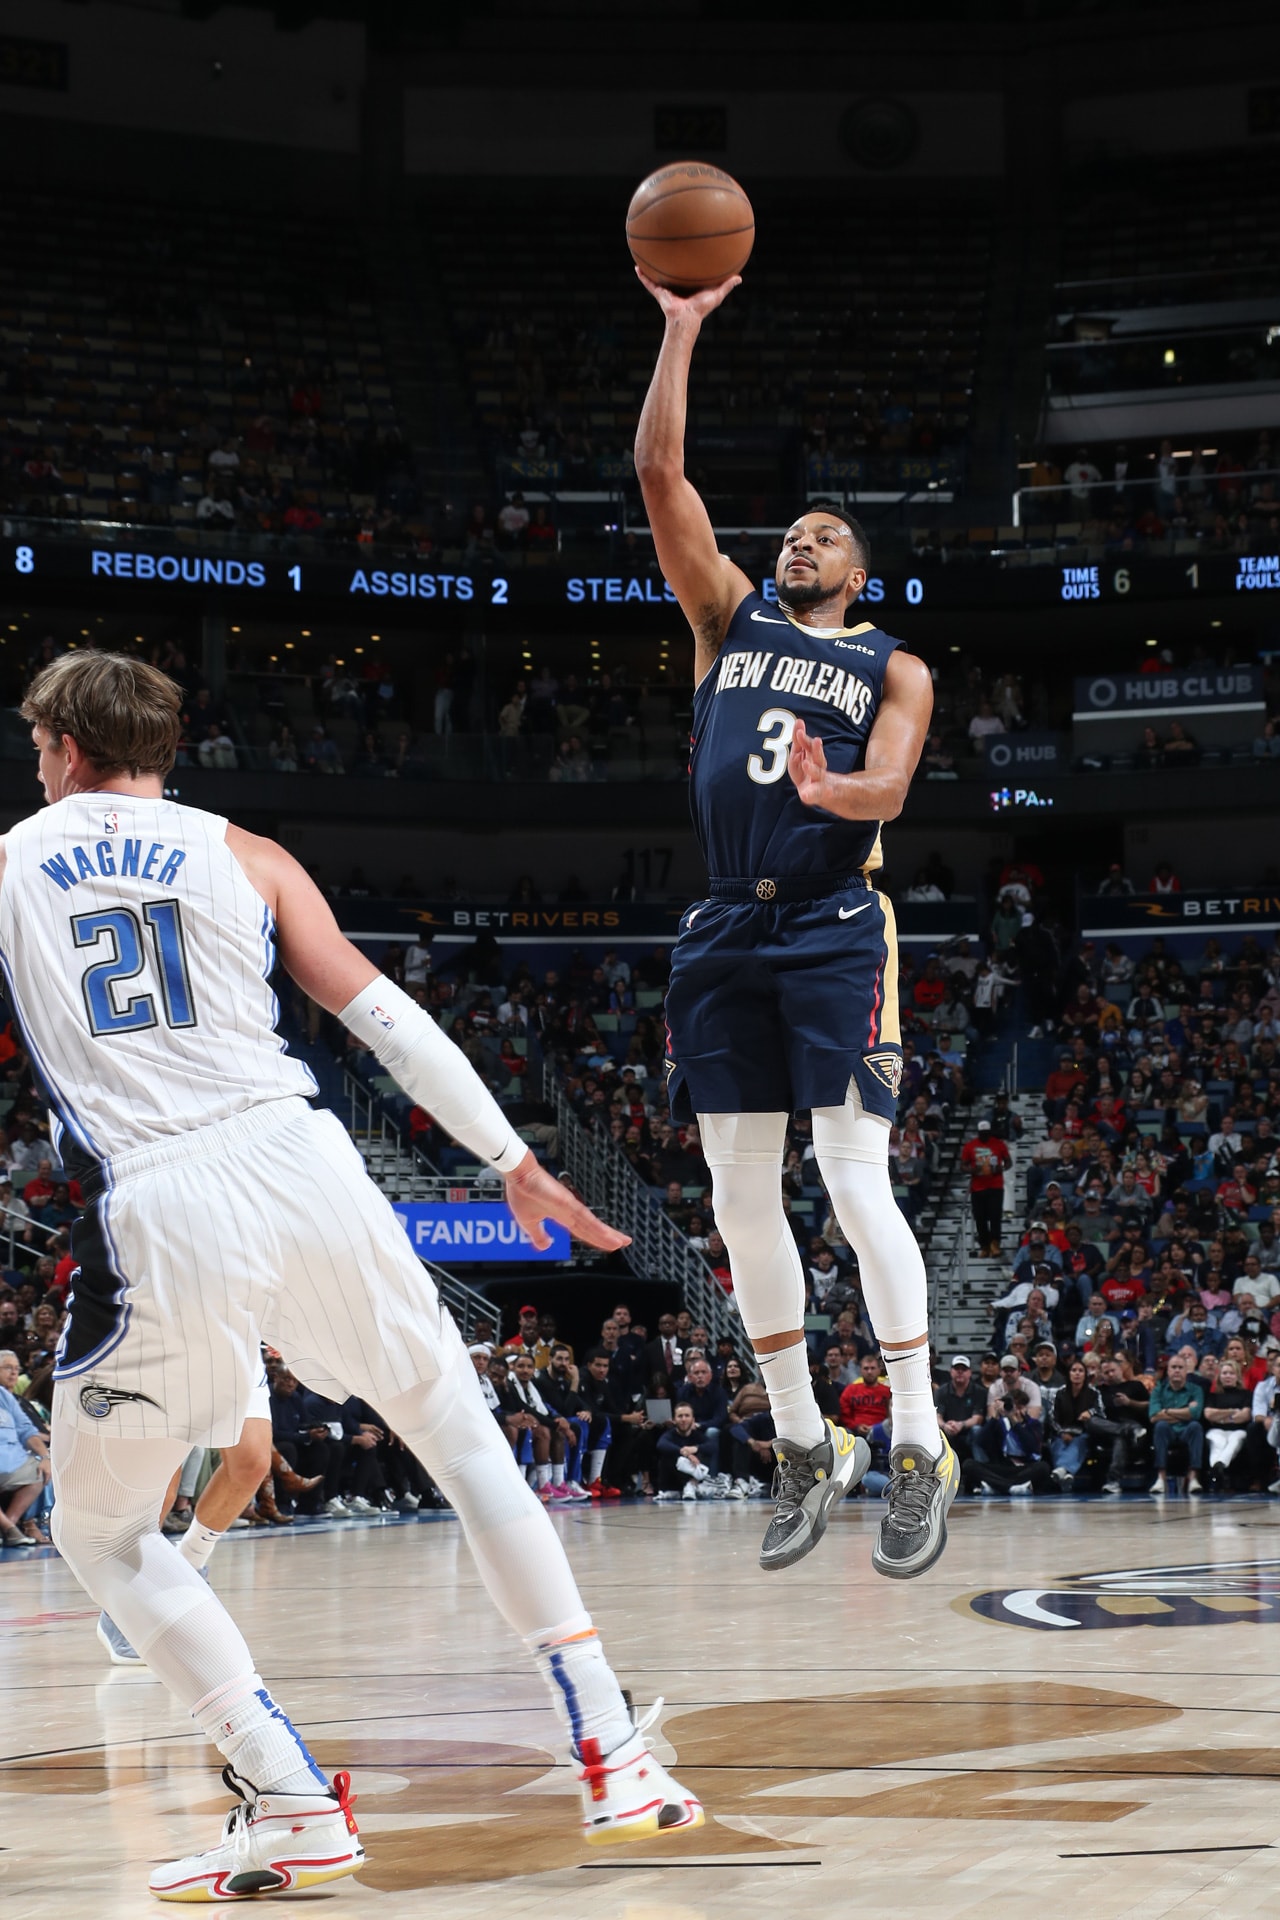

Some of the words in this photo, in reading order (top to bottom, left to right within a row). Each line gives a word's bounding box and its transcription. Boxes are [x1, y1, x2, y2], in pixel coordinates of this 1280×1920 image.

[14, 545, 35, 574] 8
[90, 549, 267, 588] REBOUNDS
[287, 564, 302, 592] 1
[349, 568, 474, 602] ASSISTS
[491, 578, 509, 605] 2
[905, 577, 924, 605] 0
[1062, 566, 1100, 584] TIME
[1185, 562, 1200, 590] 1
[1238, 555, 1280, 574] TEAM
[1060, 583, 1101, 601] OUTS
[1113, 567, 1131, 595] 6
[715, 651, 774, 696] NEW
[769, 656, 872, 726] ORLEANS
[1124, 679, 1180, 701] HUB
[1182, 675, 1253, 697] CLUB
[746, 707, 799, 785] 3
[1016, 745, 1057, 763] HUB
[39, 838, 186, 892] WAGNER
[453, 910, 620, 928] BETRIVERS
[70, 898, 197, 1038] 21
